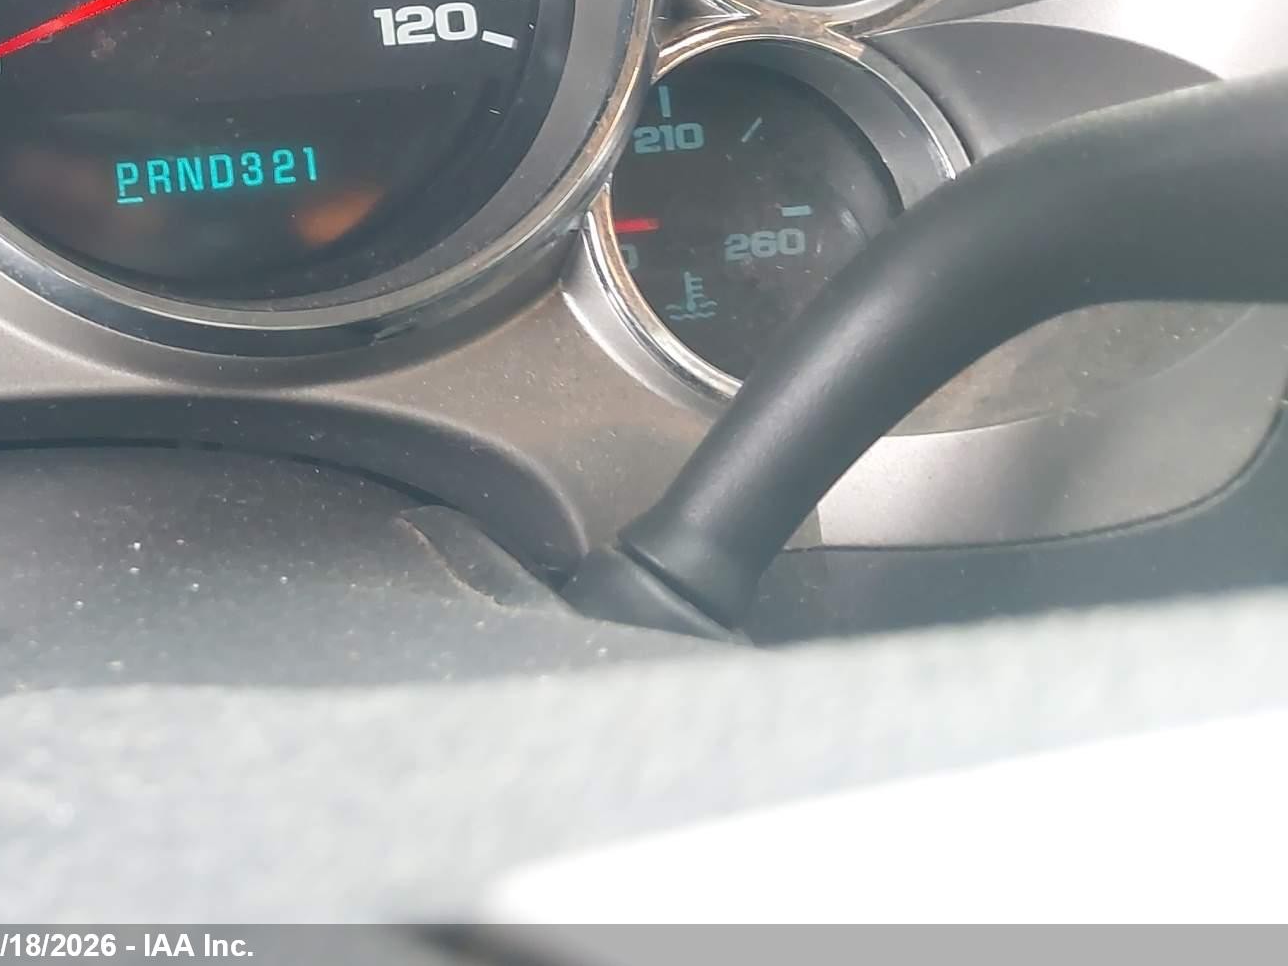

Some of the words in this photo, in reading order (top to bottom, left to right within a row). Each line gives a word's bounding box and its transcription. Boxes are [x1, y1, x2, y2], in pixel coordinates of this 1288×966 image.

[373, 2, 478, 46] 120
[634, 122, 705, 152] 210
[724, 229, 806, 258] 260
